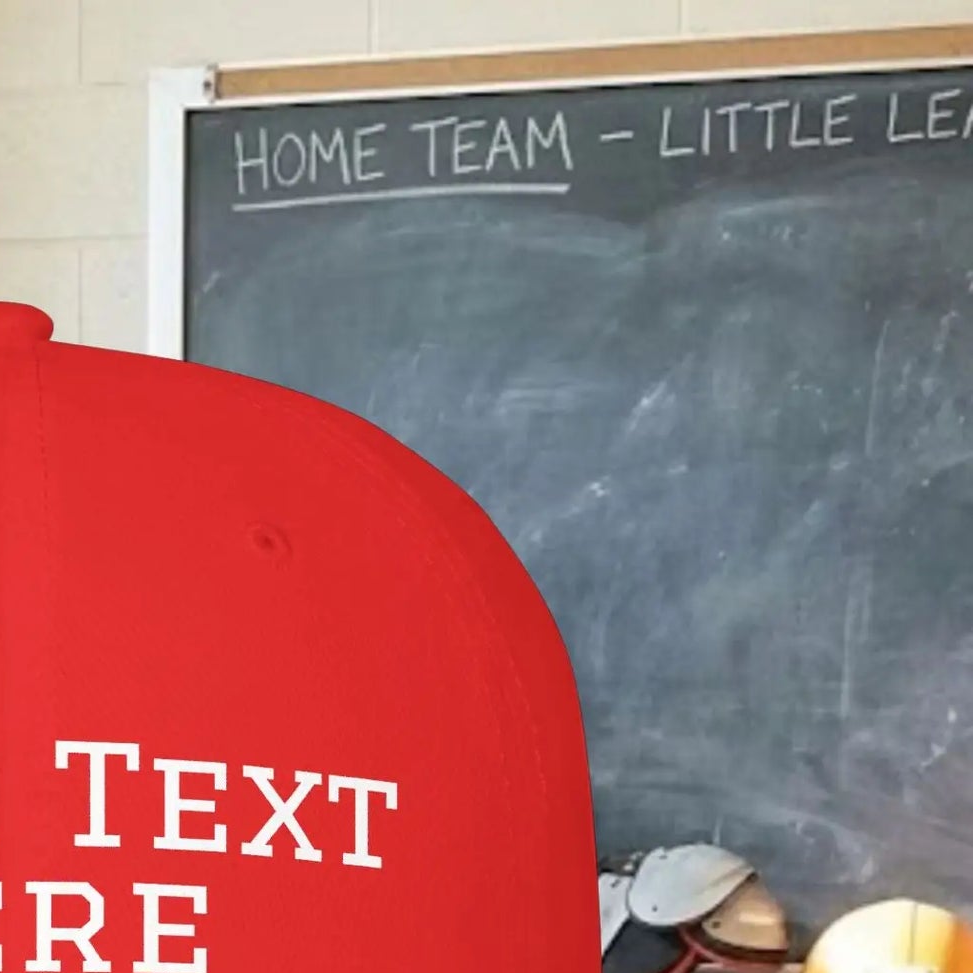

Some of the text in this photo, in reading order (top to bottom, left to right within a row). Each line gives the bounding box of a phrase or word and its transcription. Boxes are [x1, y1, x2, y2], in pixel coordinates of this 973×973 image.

[235, 123, 386, 194] HOME
[409, 110, 573, 178] TEAM
[659, 94, 857, 157] LITTLE
[55, 741, 397, 868] TEXT
